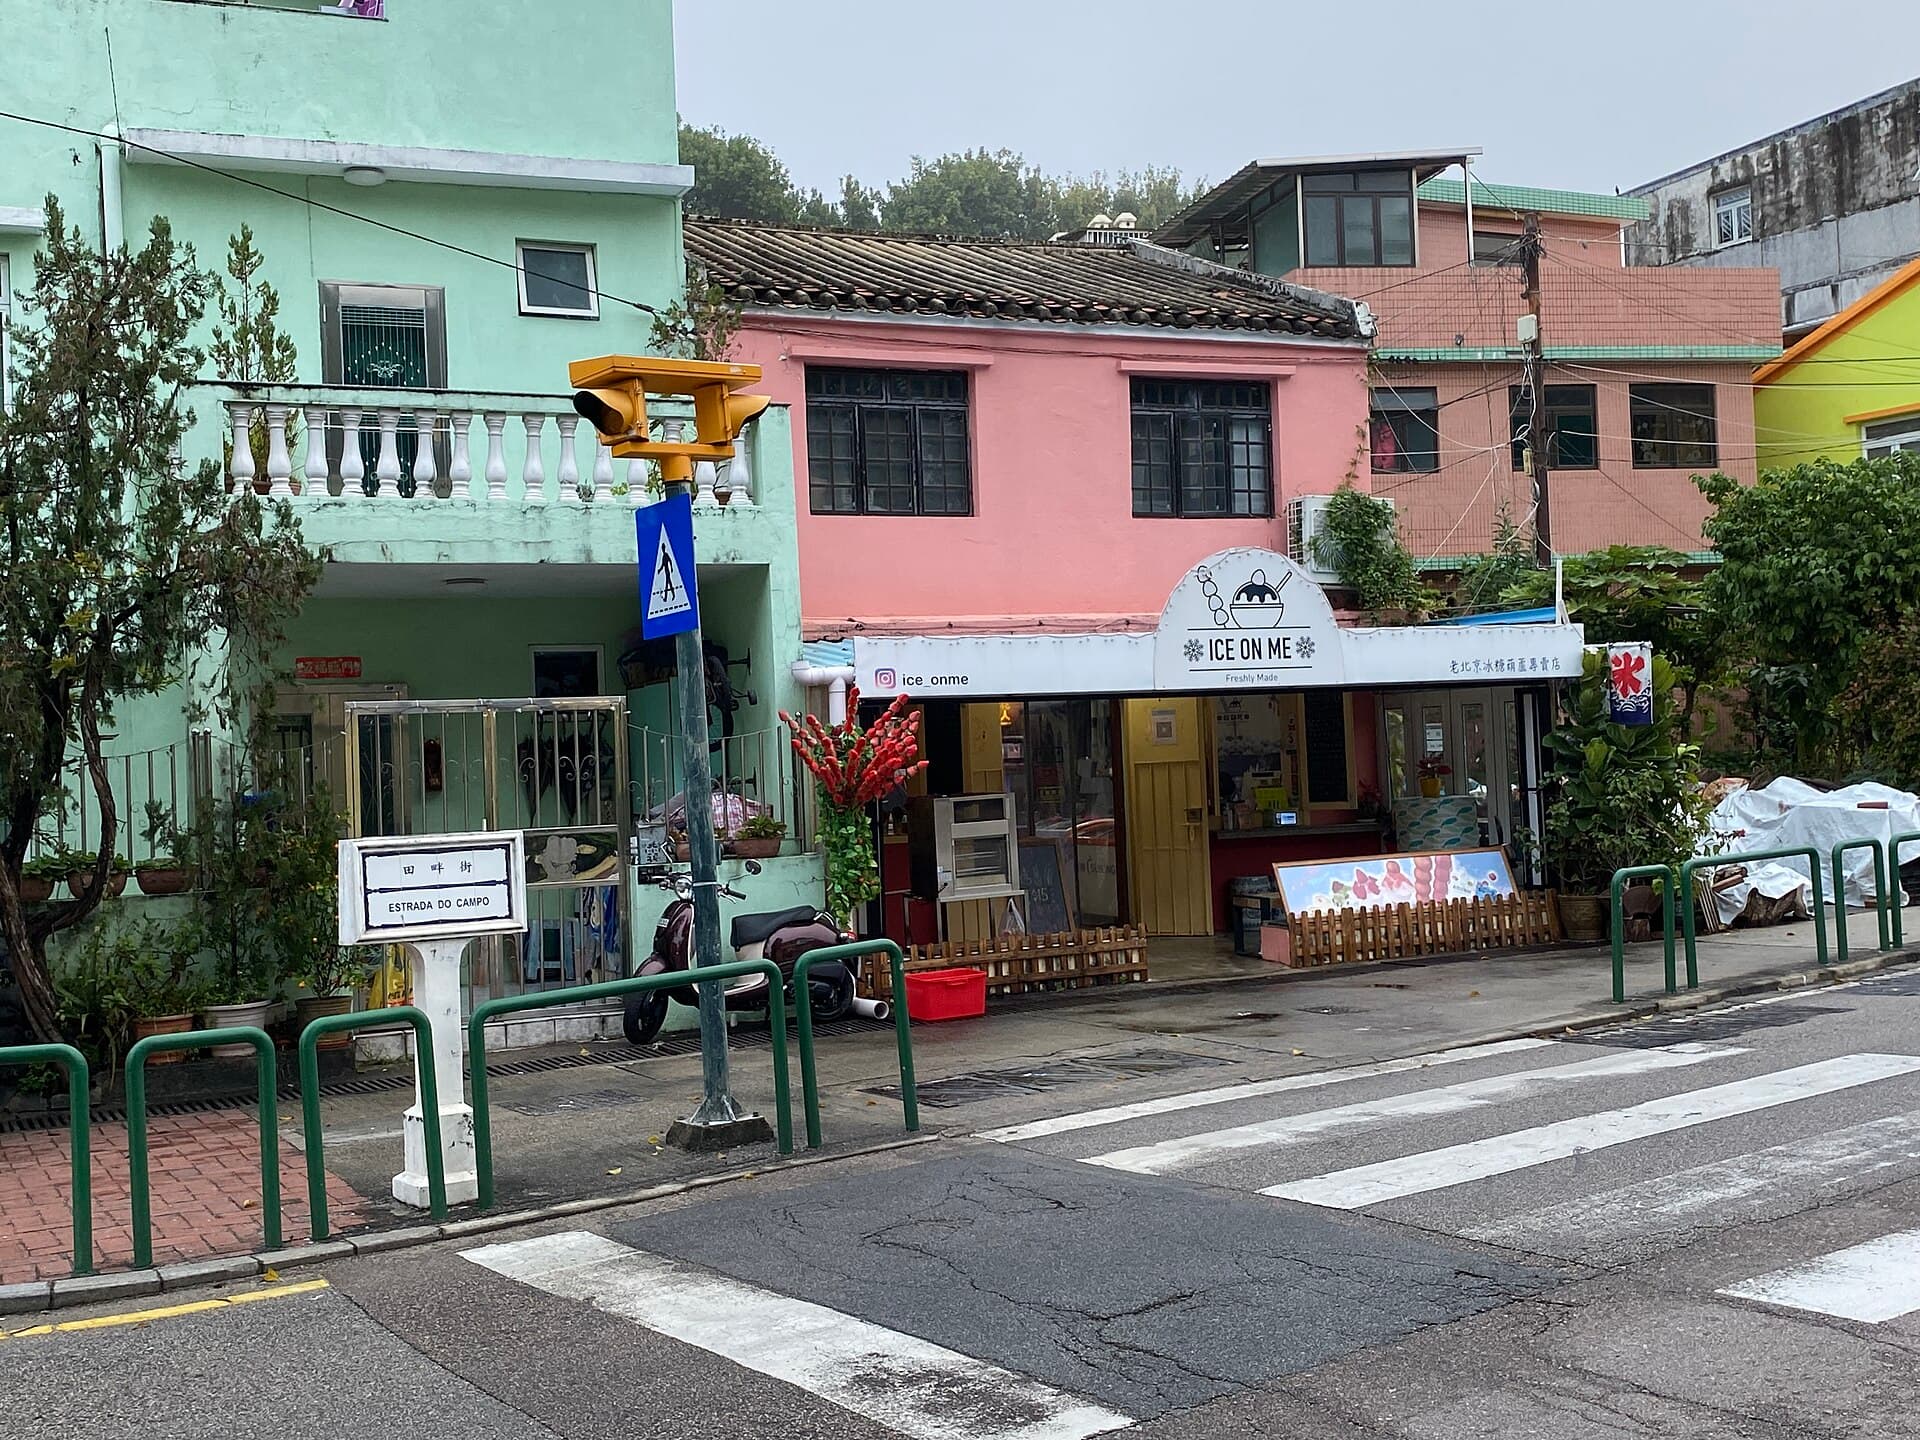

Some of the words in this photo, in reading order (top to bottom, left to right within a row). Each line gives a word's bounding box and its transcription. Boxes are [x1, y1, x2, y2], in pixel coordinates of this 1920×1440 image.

[1209, 638, 1235, 661] ICE
[1240, 637, 1262, 660] ON
[1268, 636, 1292, 659] ME
[902, 673, 969, 688] ice_onme
[1225, 674, 1255, 683] Freshly
[1256, 673, 1279, 682] Made
[388, 901, 433, 913] ESTRADA
[437, 899, 452, 909] DO
[456, 896, 490, 908] CAMPO
